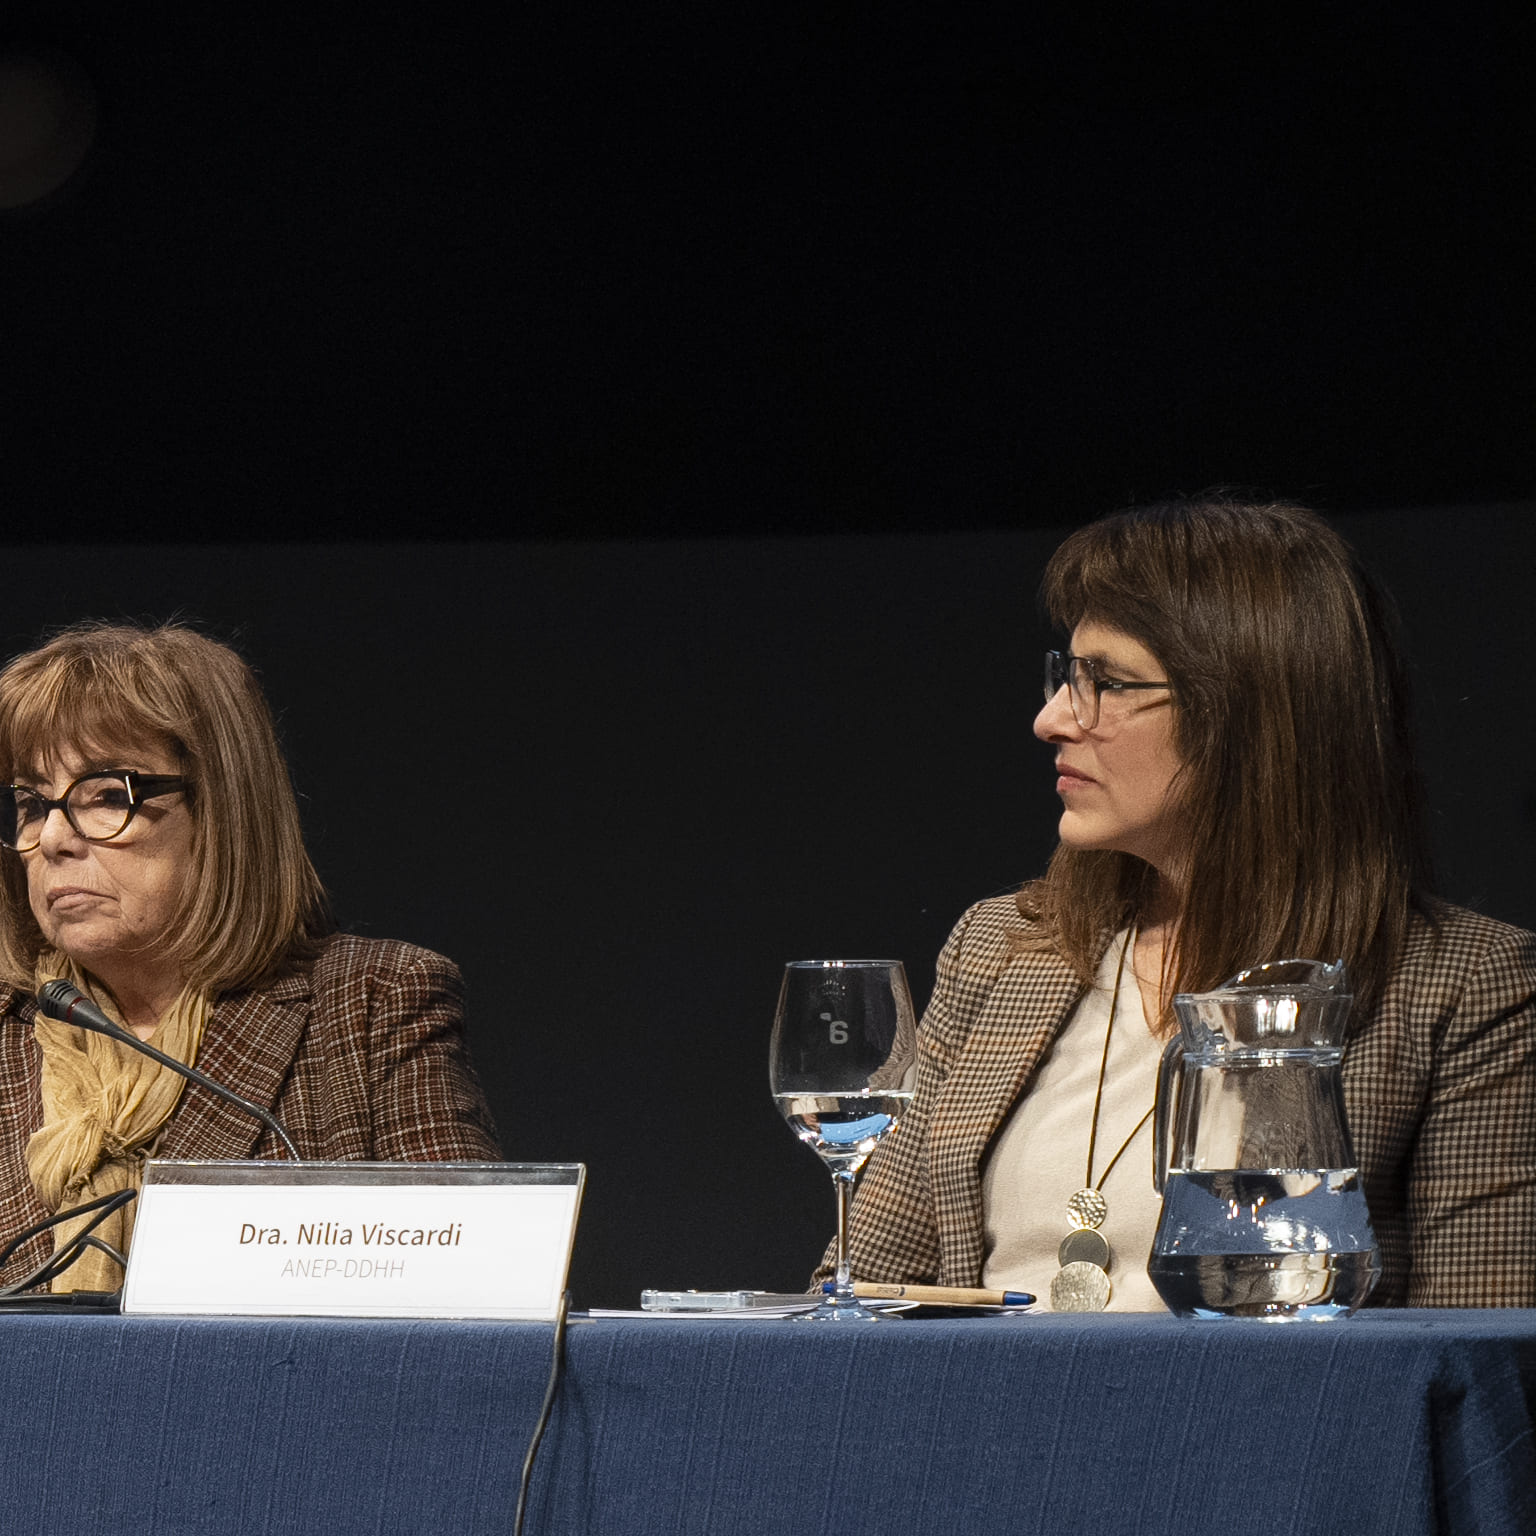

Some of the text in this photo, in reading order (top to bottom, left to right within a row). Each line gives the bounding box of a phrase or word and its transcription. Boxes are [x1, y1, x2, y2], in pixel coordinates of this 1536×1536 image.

[240, 1222, 463, 1247] Dra. Nilia Viscardi
[281, 1258, 405, 1279] ANEP-DDHH
